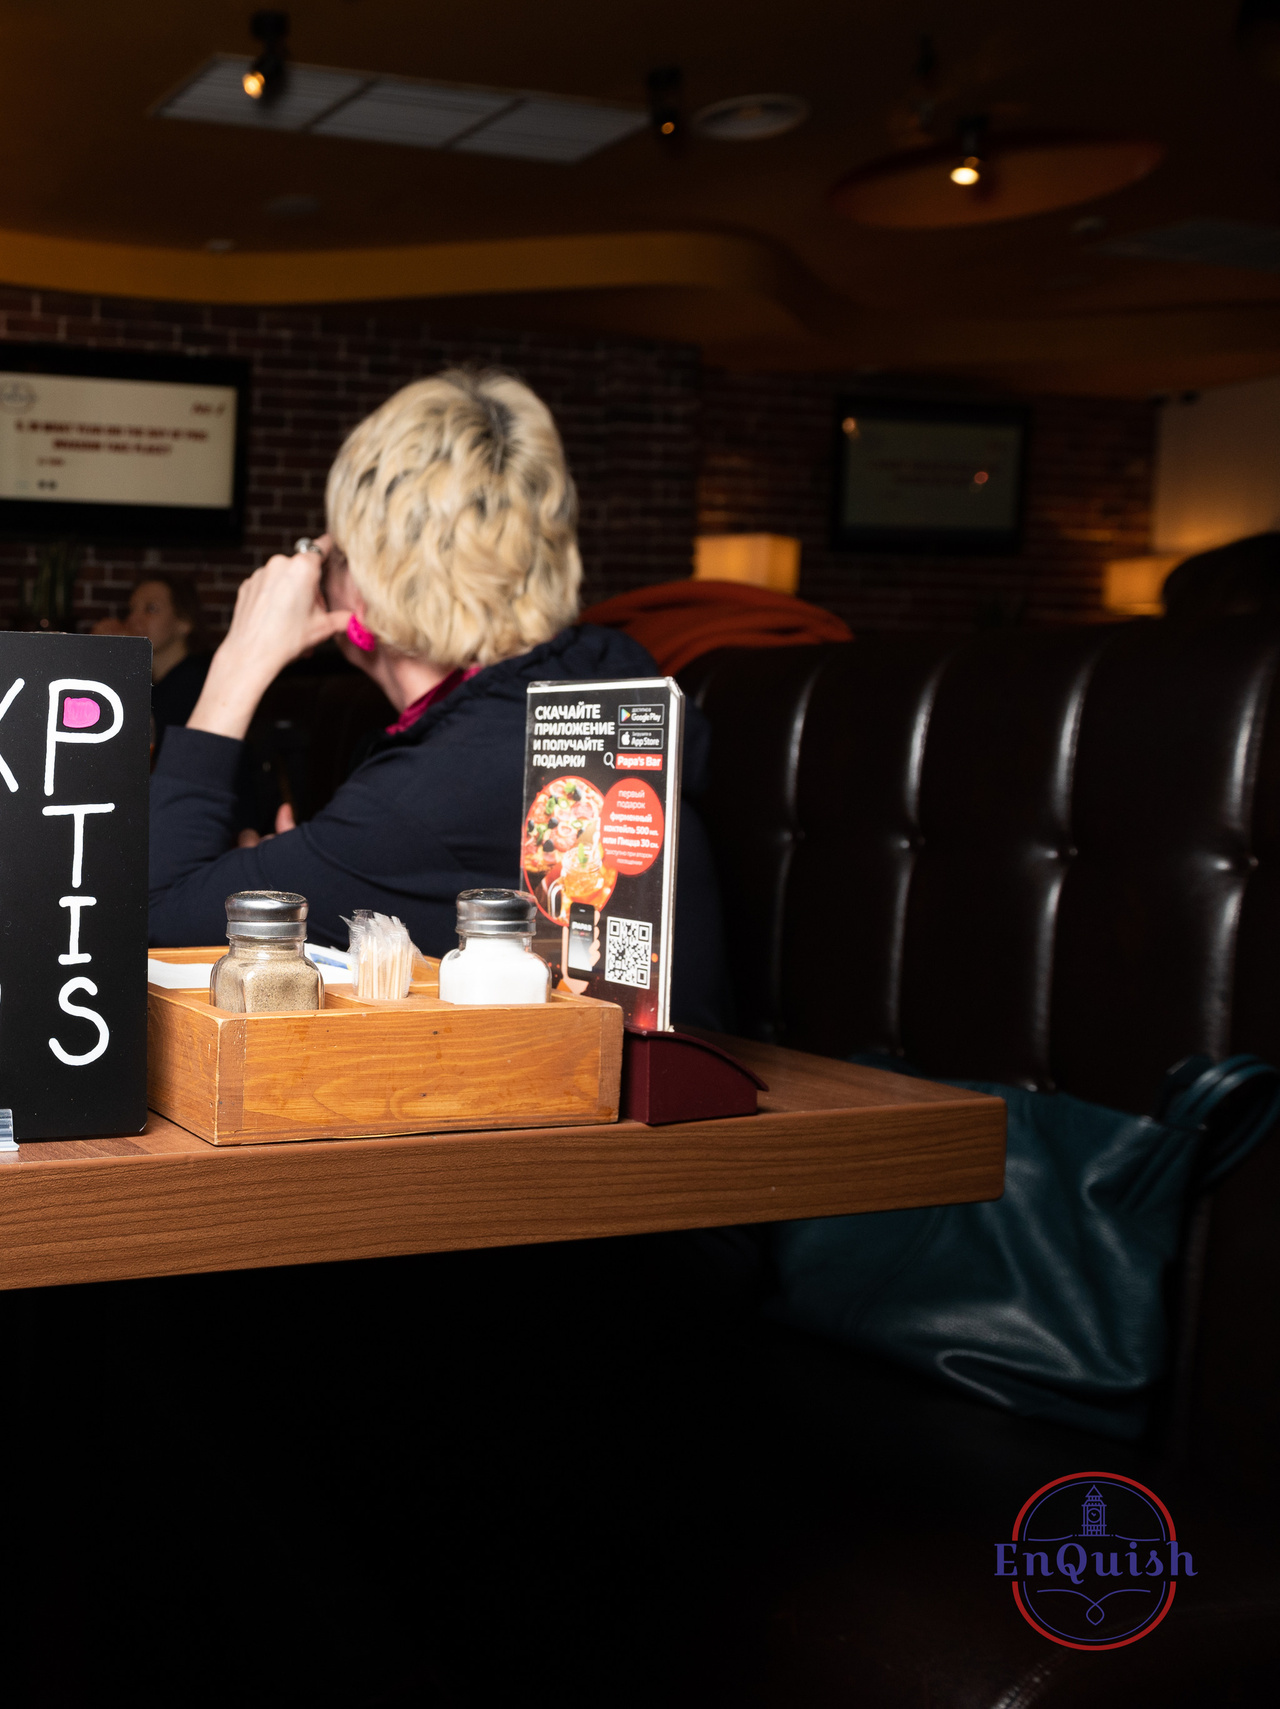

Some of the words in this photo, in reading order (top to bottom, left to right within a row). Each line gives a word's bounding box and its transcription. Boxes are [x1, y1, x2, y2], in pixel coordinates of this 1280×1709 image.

[534, 701, 601, 720] СКАЧАЙТЕ
[631, 712, 650, 723] Google
[650, 712, 661, 722] Play
[533, 722, 615, 736] ПРИЛОЖЕНИЕ
[533, 739, 541, 751] И
[542, 737, 604, 751] ПОЛУЧАЙТЕ
[631, 737, 643, 747] App
[643, 737, 659, 746] Store
[532, 754, 586, 769] ПОДАРКИ
[617, 756, 645, 768] Papa's
[646, 756, 662, 766] Bar
[618, 789, 645, 799] первый
[616, 800, 646, 810] подарок
[636, 826, 650, 835] 500
[640, 838, 650, 848] 30
